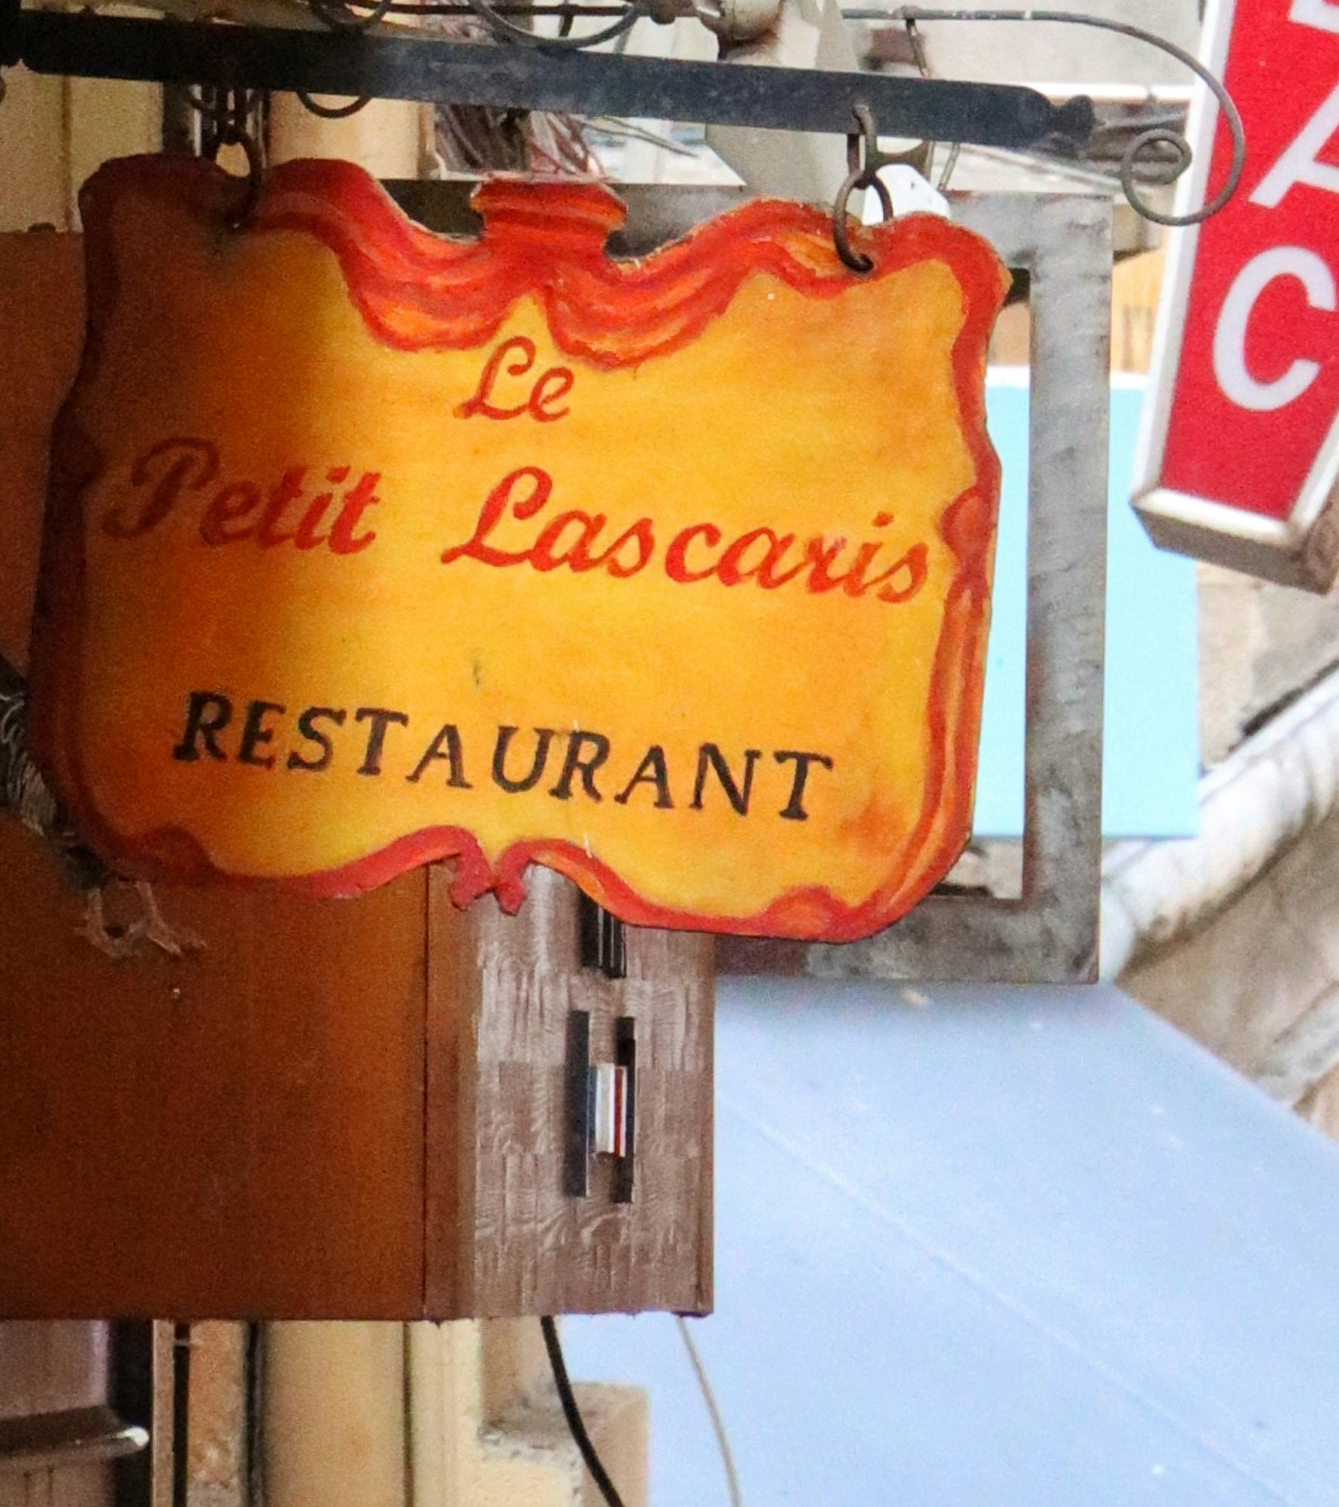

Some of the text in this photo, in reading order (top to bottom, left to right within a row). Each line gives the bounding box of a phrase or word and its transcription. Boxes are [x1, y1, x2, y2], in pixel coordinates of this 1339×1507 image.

[452, 336, 575, 422] Le
[100, 435, 928, 604] Petit Lascaris
[173, 691, 834, 822] RESTAURANT
